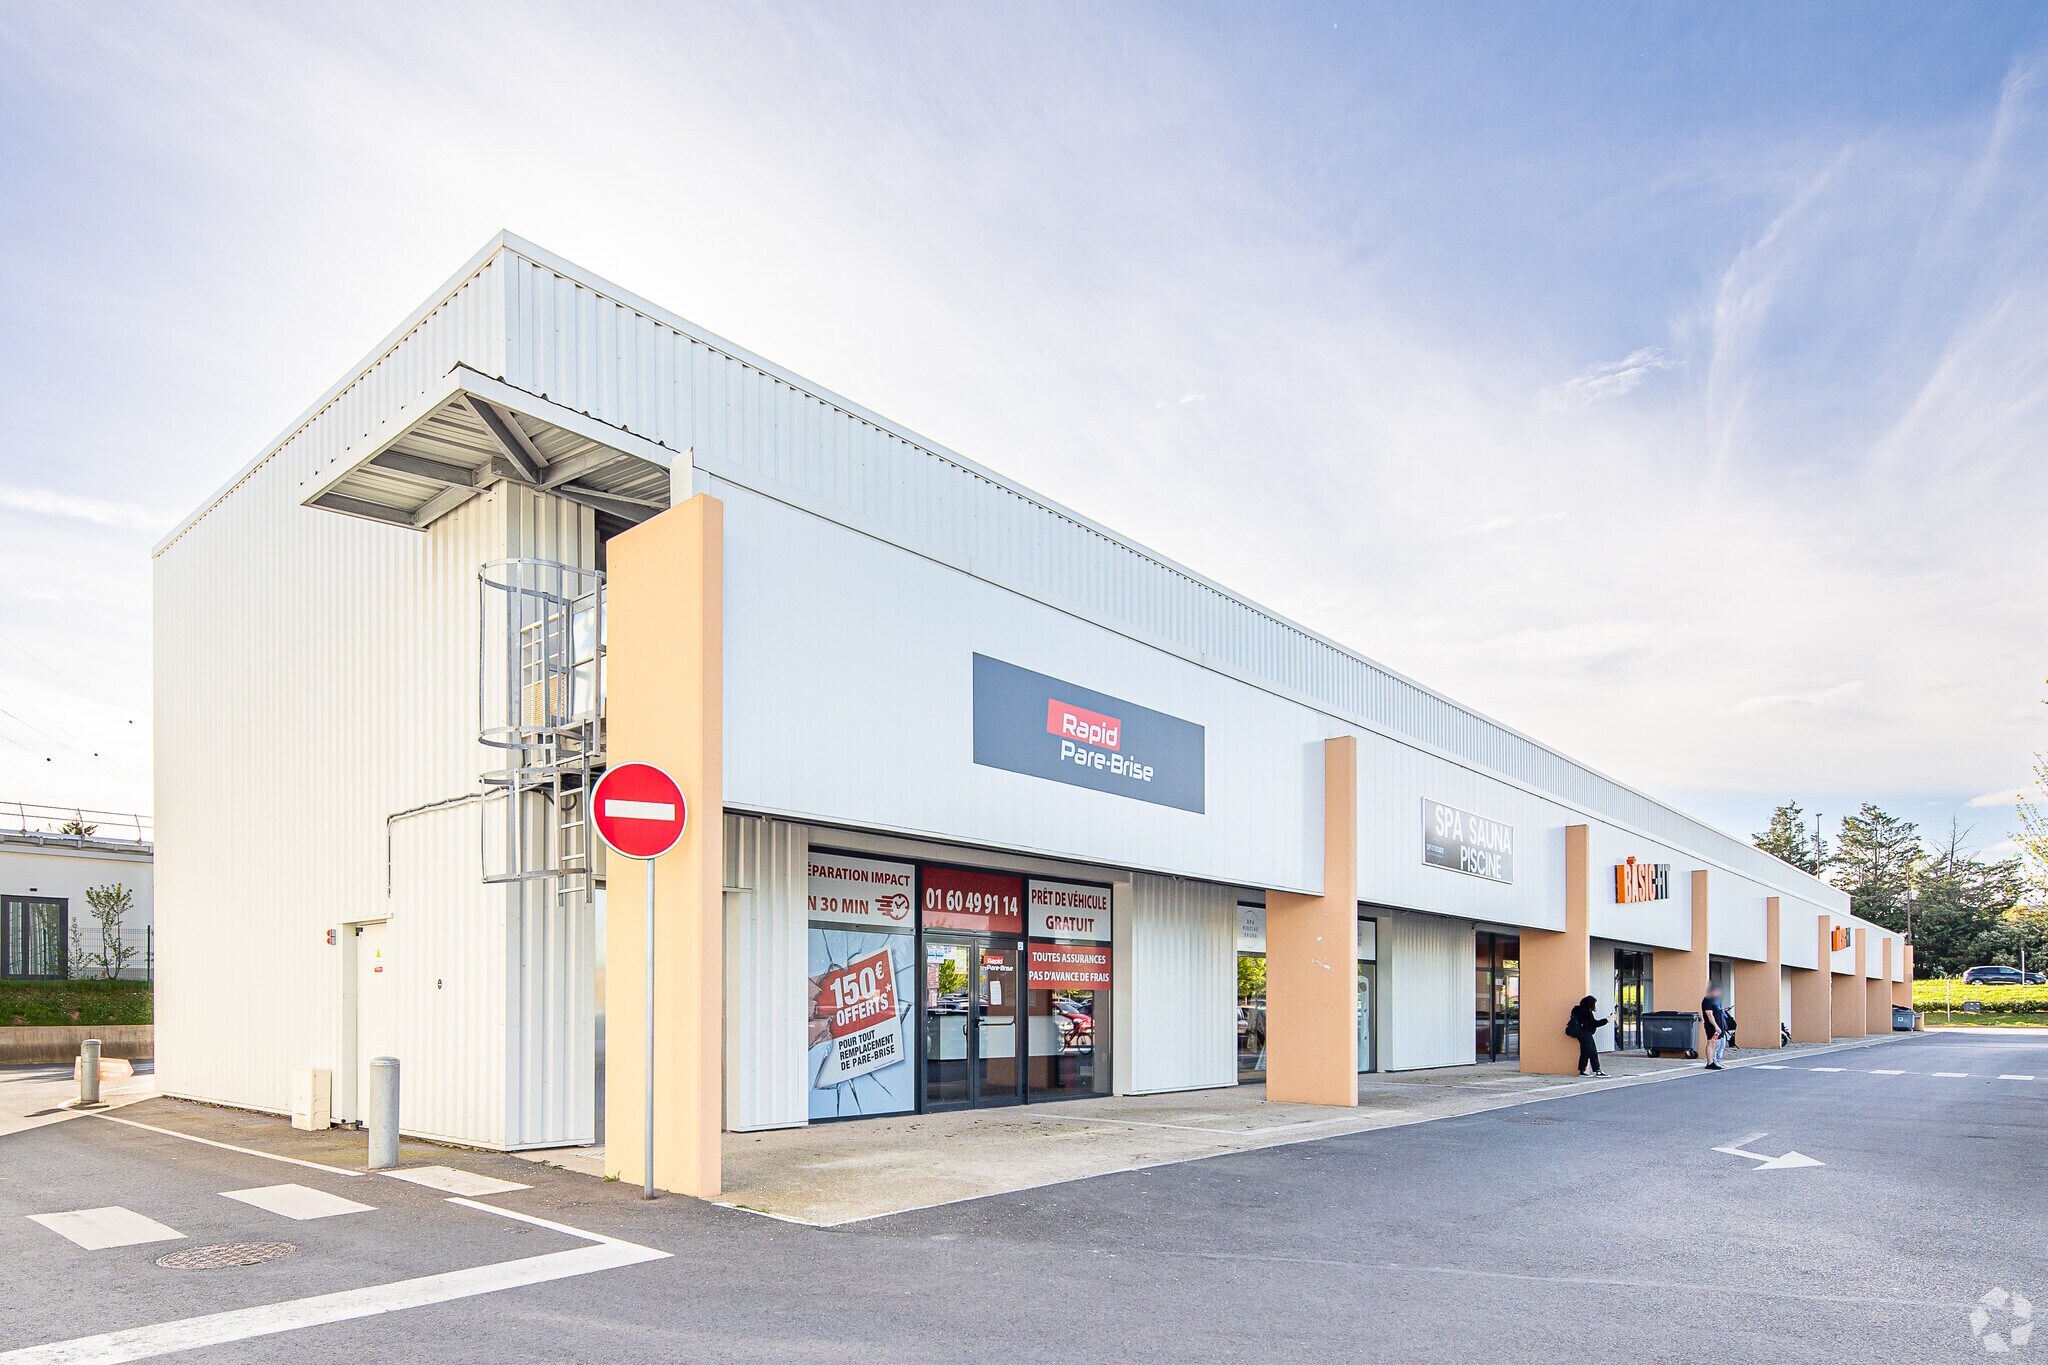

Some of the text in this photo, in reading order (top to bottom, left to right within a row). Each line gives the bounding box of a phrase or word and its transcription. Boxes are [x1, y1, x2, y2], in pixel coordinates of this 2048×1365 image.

[1062, 713, 1118, 746] Rapid
[1060, 739, 1154, 782] Pare-Brise
[1435, 805, 1512, 855] SPA SAUNA
[808, 861, 911, 886] ÉPARATION IMPACT
[1460, 845, 1502, 878] PISCINE
[808, 895, 869, 915] N 30 MIN
[926, 887, 1018, 916] 01 60 49 91 14
[1031, 887, 1107, 910] PRÊT DE VÉHICULE
[1045, 915, 1095, 932] GRATUIT
[1032, 951, 1106, 964] TOUTES ASSURANCES
[1028, 970, 1109, 982] PAS D'AVANCE DE FRAIS
[838, 1030, 876, 1050] POUR TOUT
[839, 1034, 894, 1061] REMPLACEMENT
[840, 1060, 851, 1071] DE
[852, 1045, 896, 1068] PARE-BRISE
